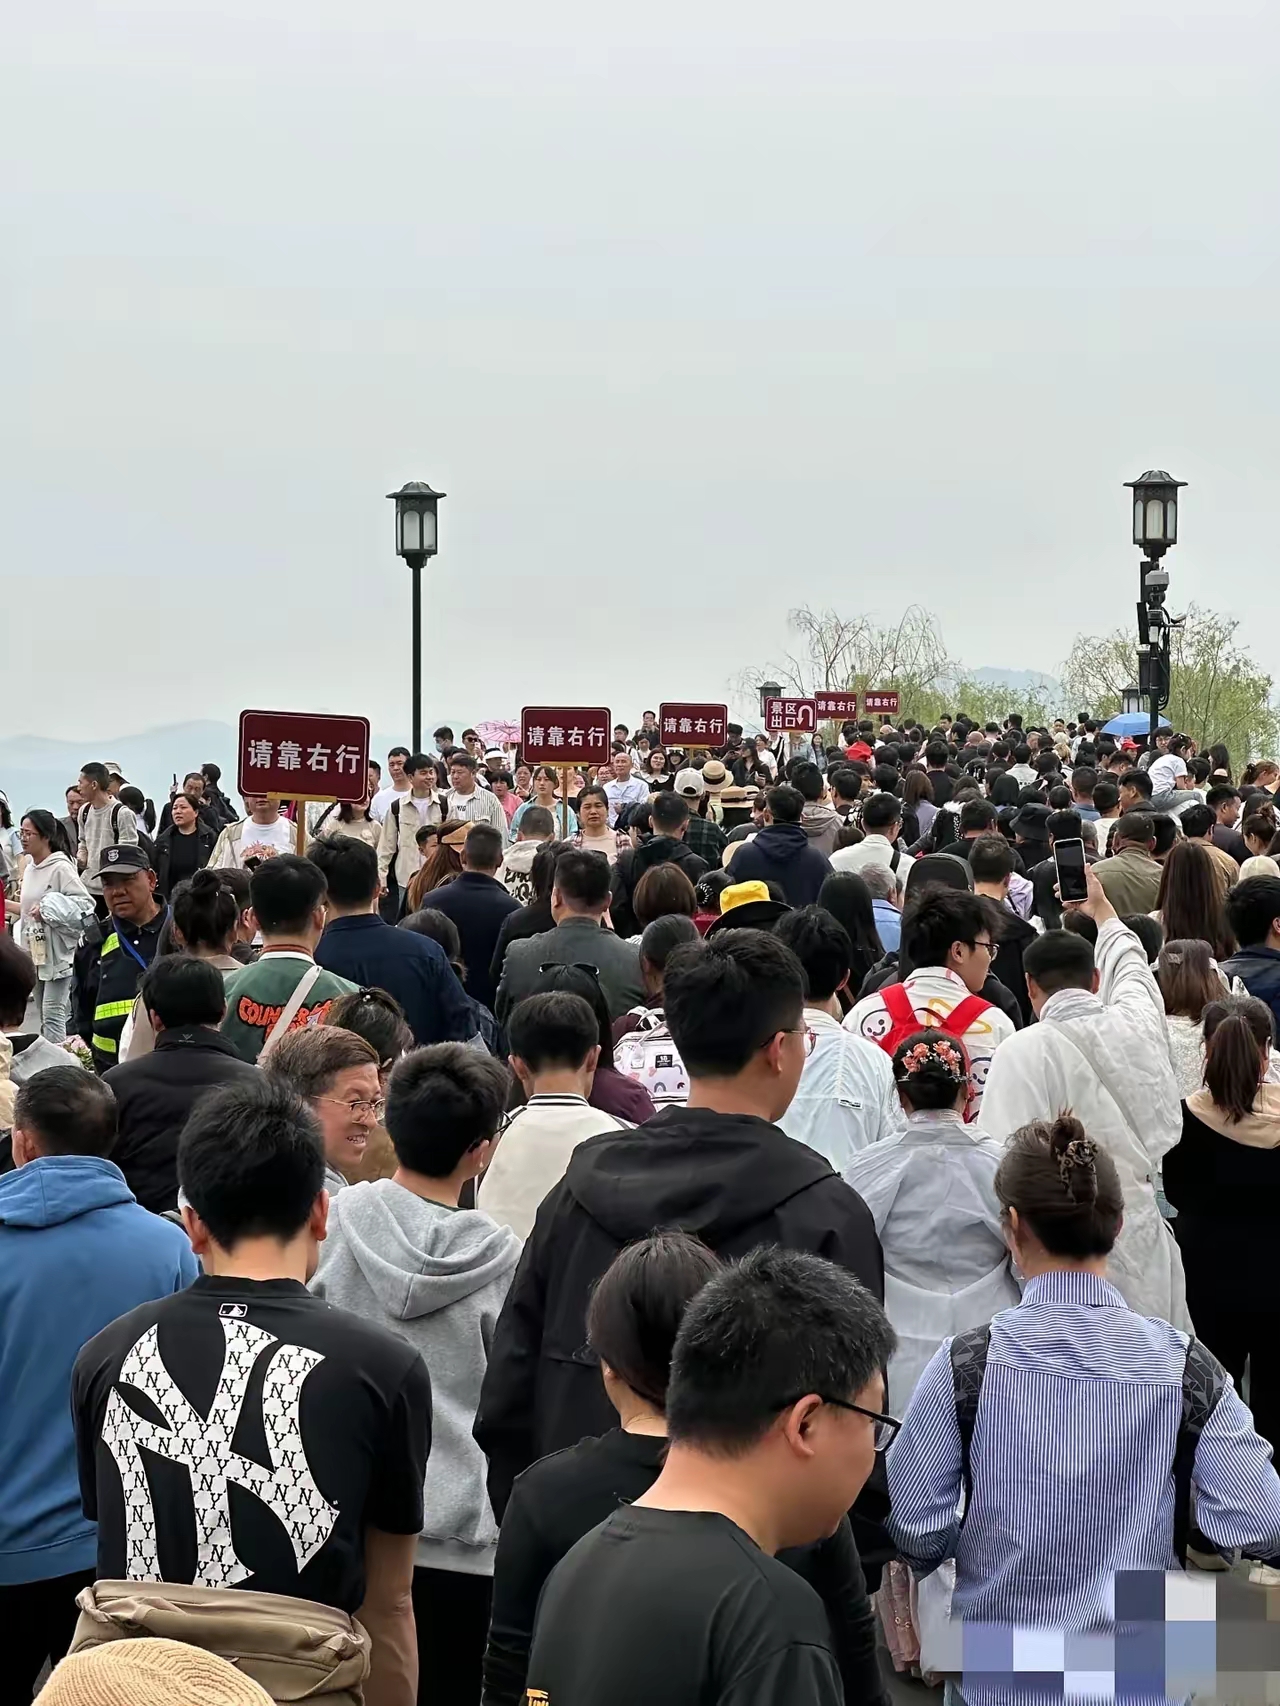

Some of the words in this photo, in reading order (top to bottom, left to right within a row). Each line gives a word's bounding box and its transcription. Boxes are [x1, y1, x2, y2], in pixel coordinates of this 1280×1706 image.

[771, 702, 796, 714] 景区
[818, 702, 855, 711] 请靠右行
[664, 718, 723, 734] 请靠右行
[771, 715, 796, 728] 出口
[527, 726, 605, 747] 请靠右行
[248, 740, 360, 774] 请靠右行
